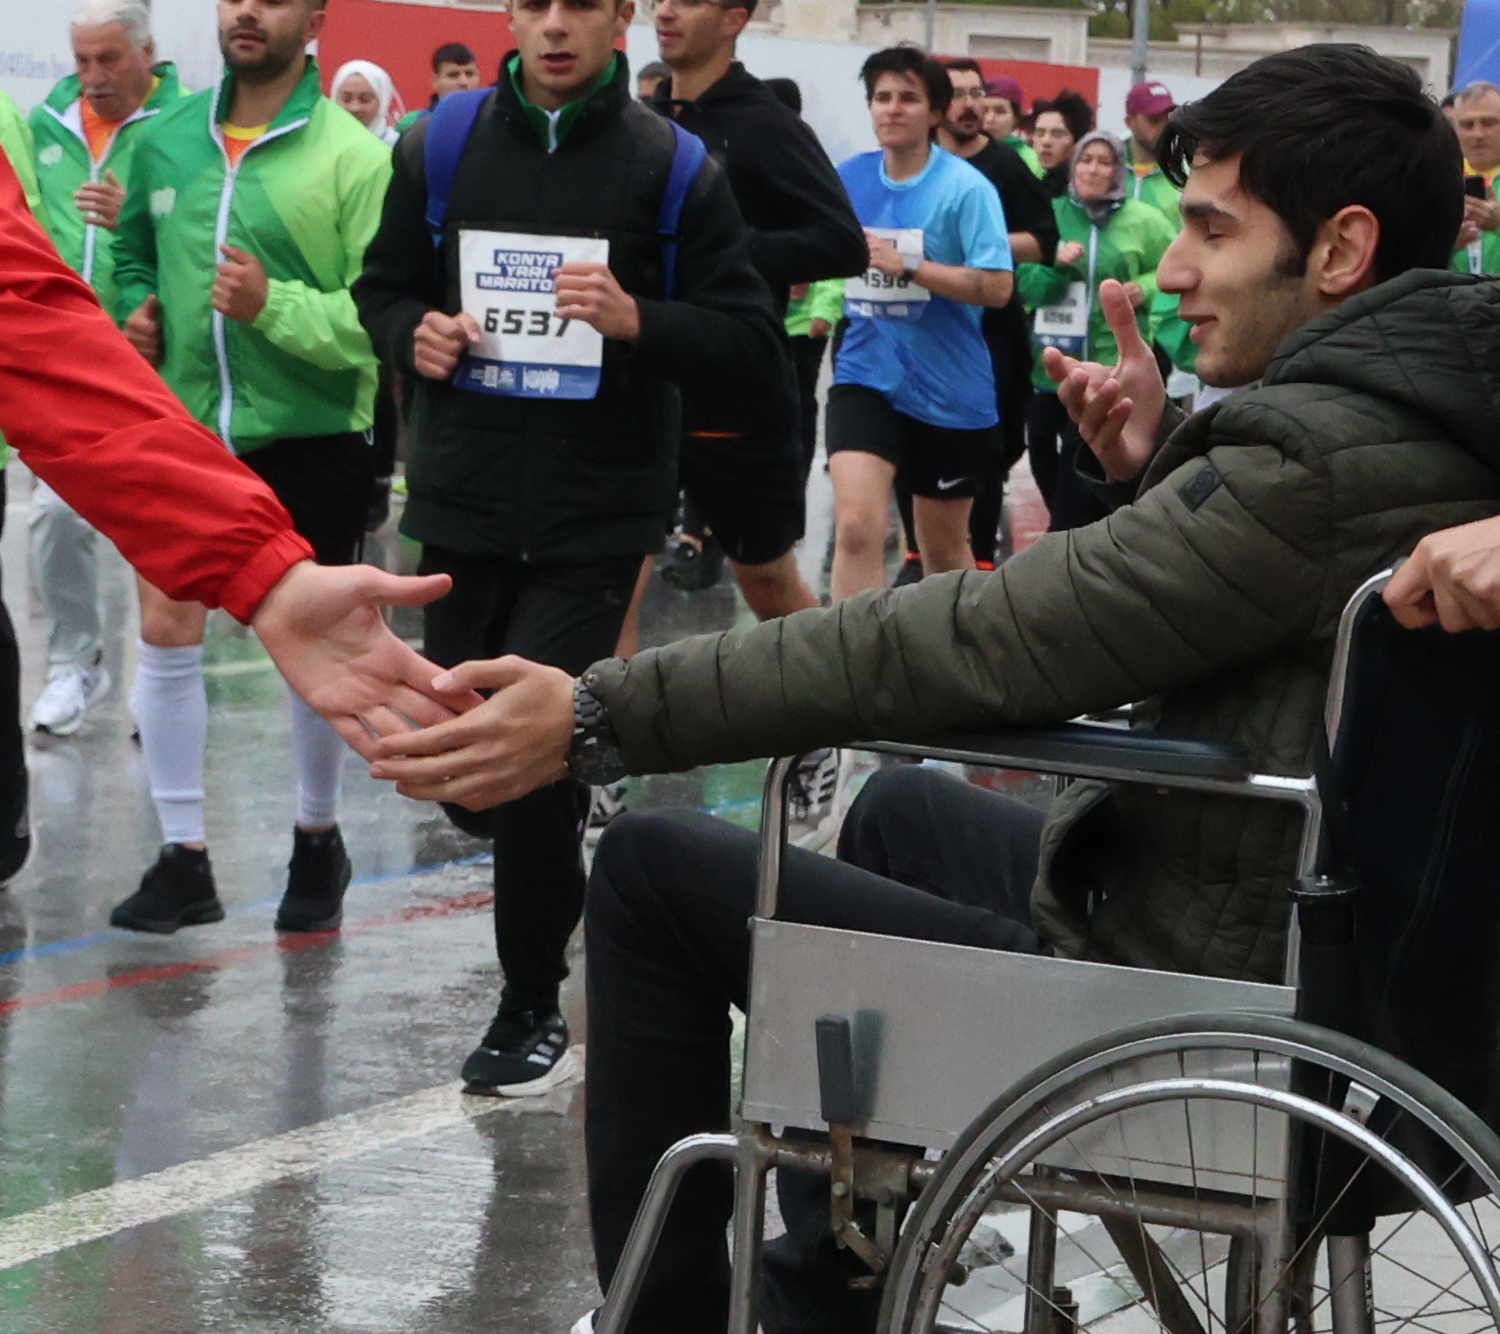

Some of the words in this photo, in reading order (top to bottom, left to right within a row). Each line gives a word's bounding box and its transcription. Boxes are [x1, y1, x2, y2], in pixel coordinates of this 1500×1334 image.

[497, 252, 560, 267] KONYA
[506, 265, 548, 279] YARI
[480, 277, 555, 291] MARATO
[484, 308, 571, 337] 6537
